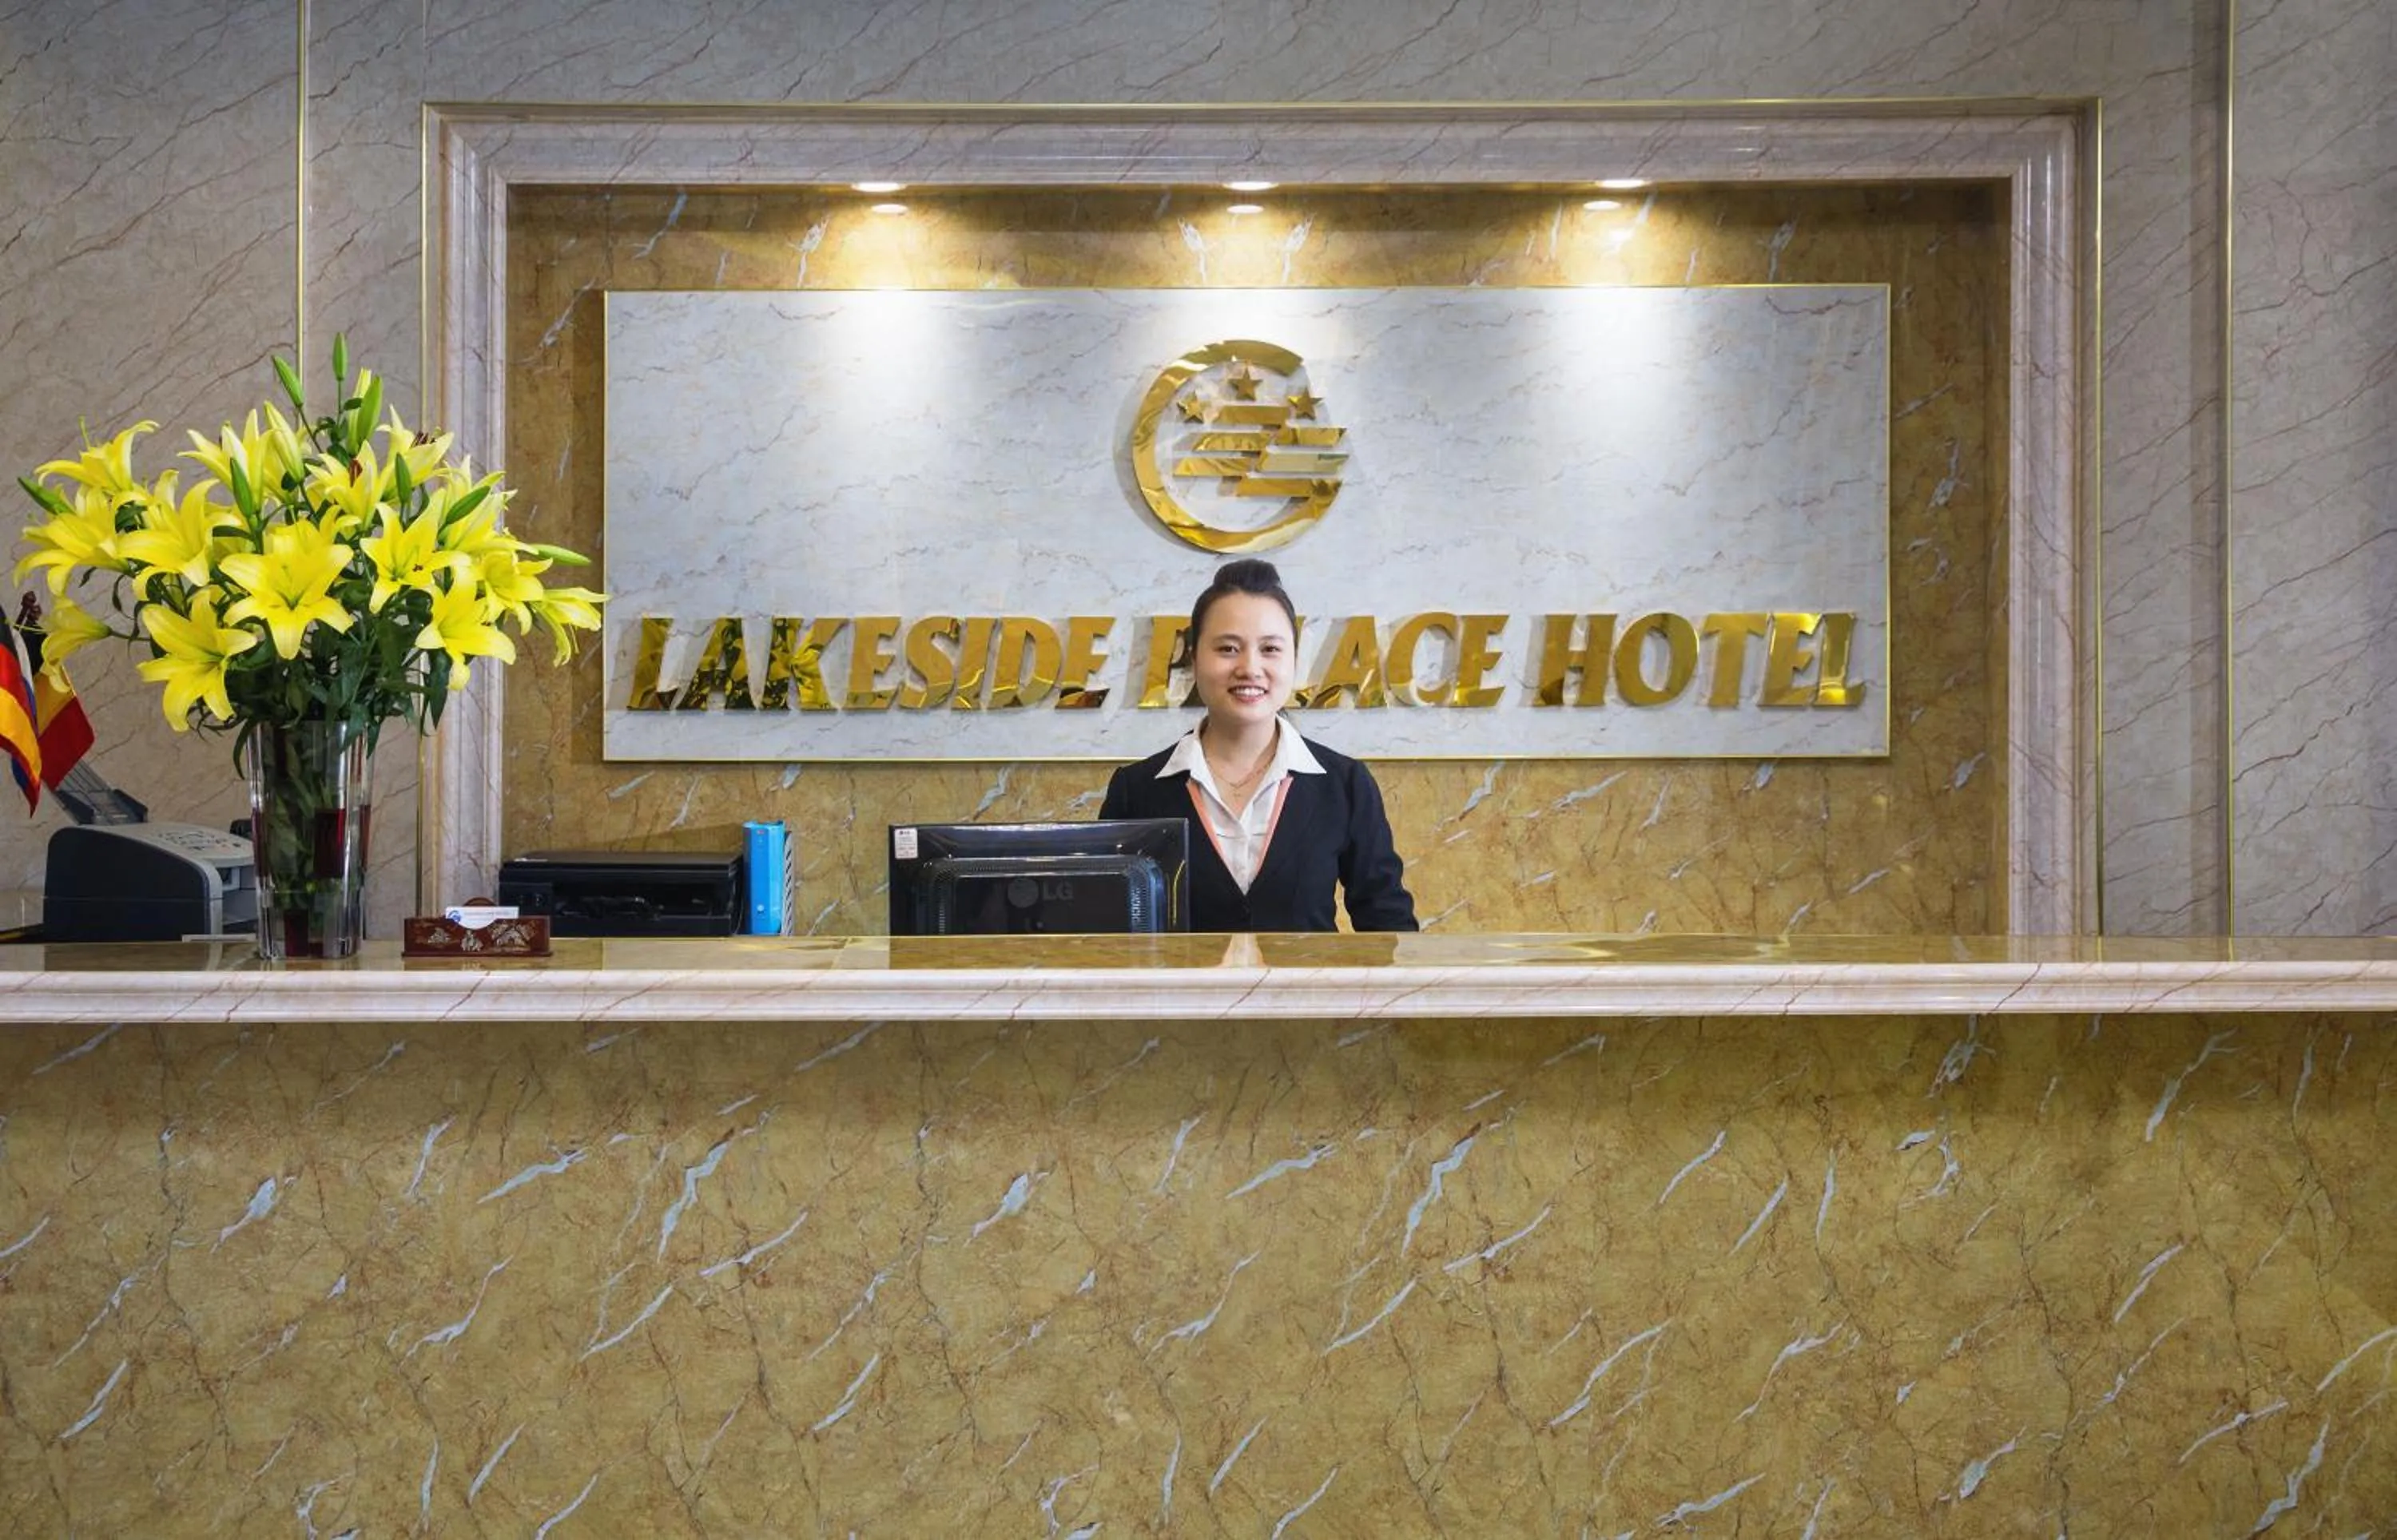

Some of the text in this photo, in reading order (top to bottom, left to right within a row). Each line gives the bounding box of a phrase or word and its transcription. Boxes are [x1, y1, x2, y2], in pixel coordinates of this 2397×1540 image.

[626, 612, 1868, 710] LAKESIDE PACE HOTEL
[1042, 879, 1073, 901] LG
